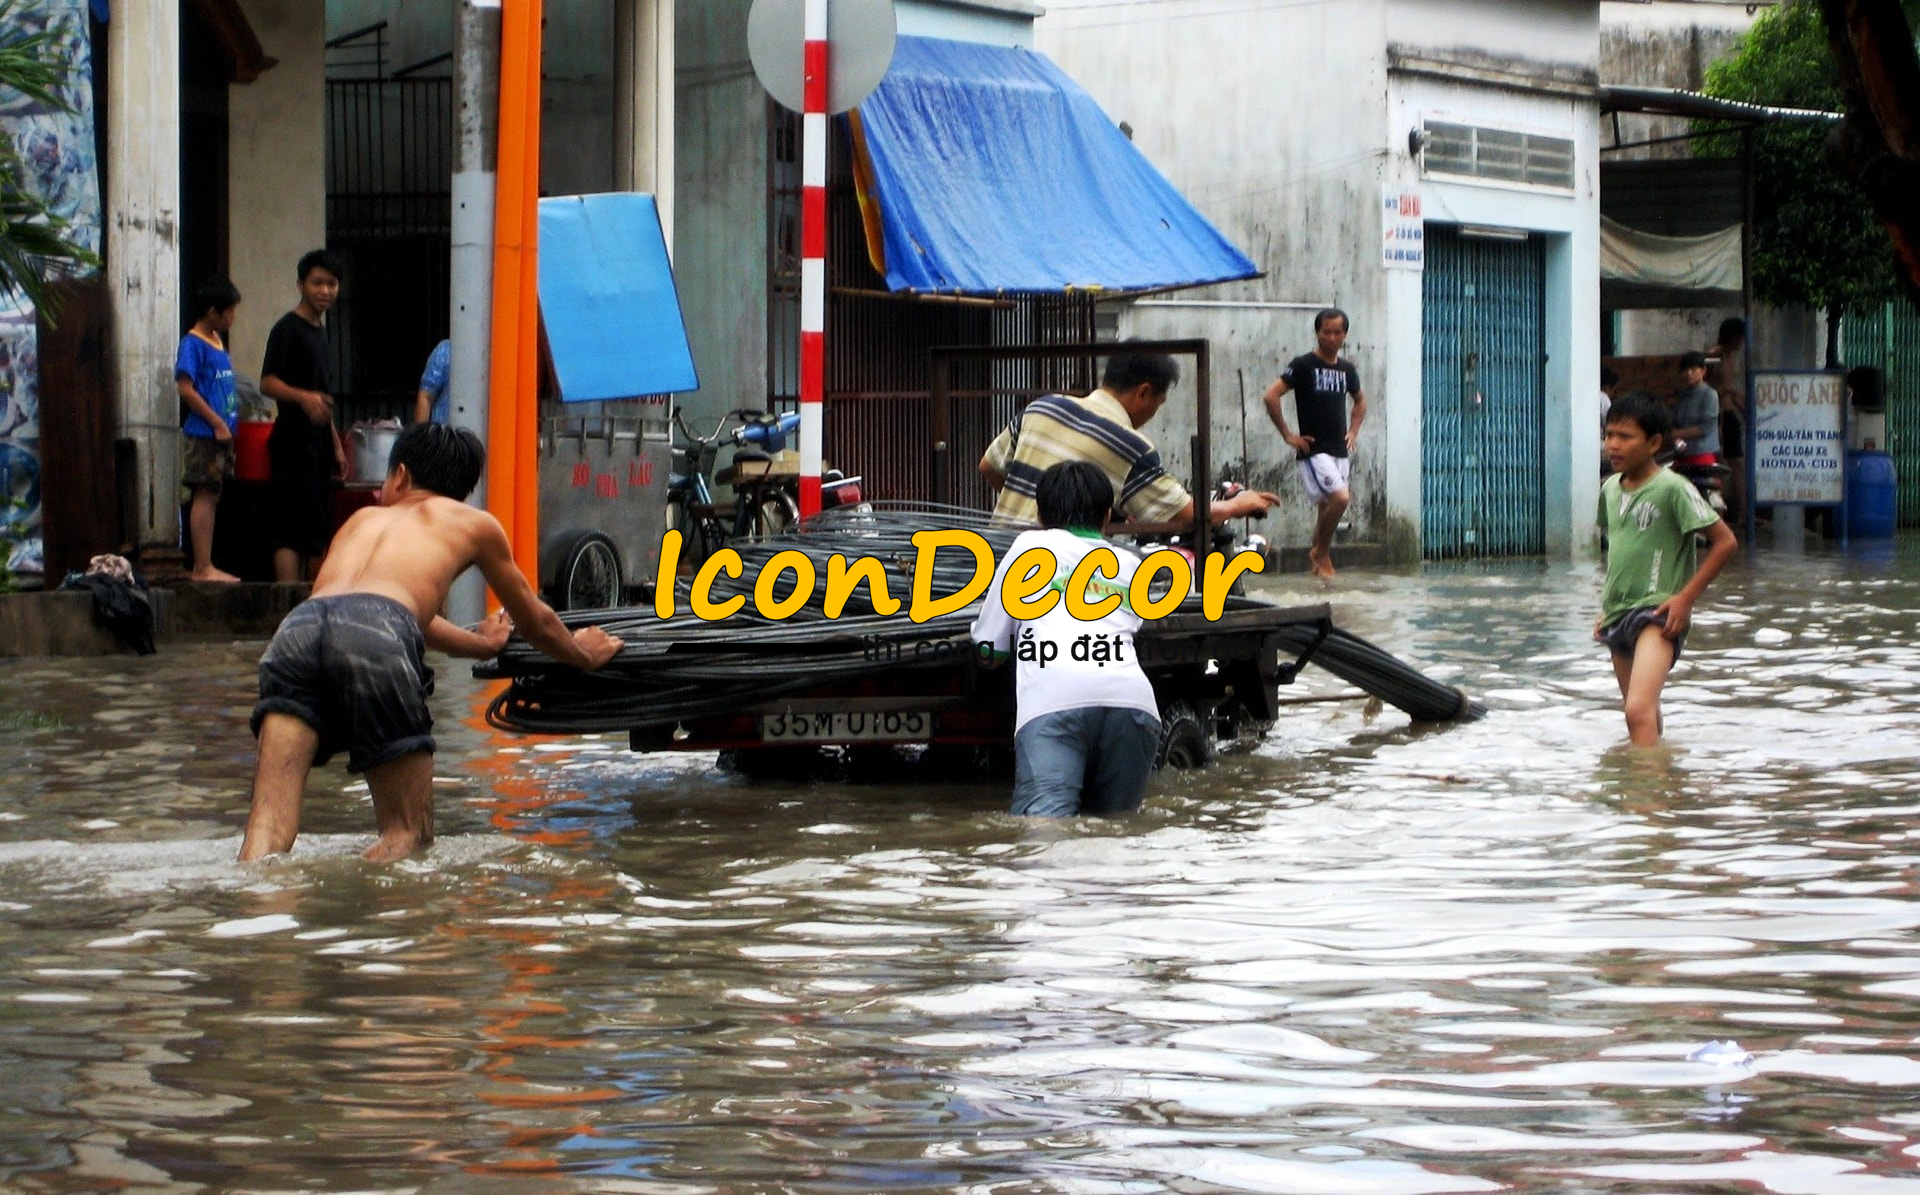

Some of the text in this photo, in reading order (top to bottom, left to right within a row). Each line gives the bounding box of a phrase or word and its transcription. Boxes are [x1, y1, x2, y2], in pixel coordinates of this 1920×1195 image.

[1757, 374, 1841, 408] QUỐC ÁNH
[1772, 445, 1791, 457] CÁC
[1793, 445, 1813, 458] LOẠI
[1761, 458, 1838, 469] HONDA CUB
